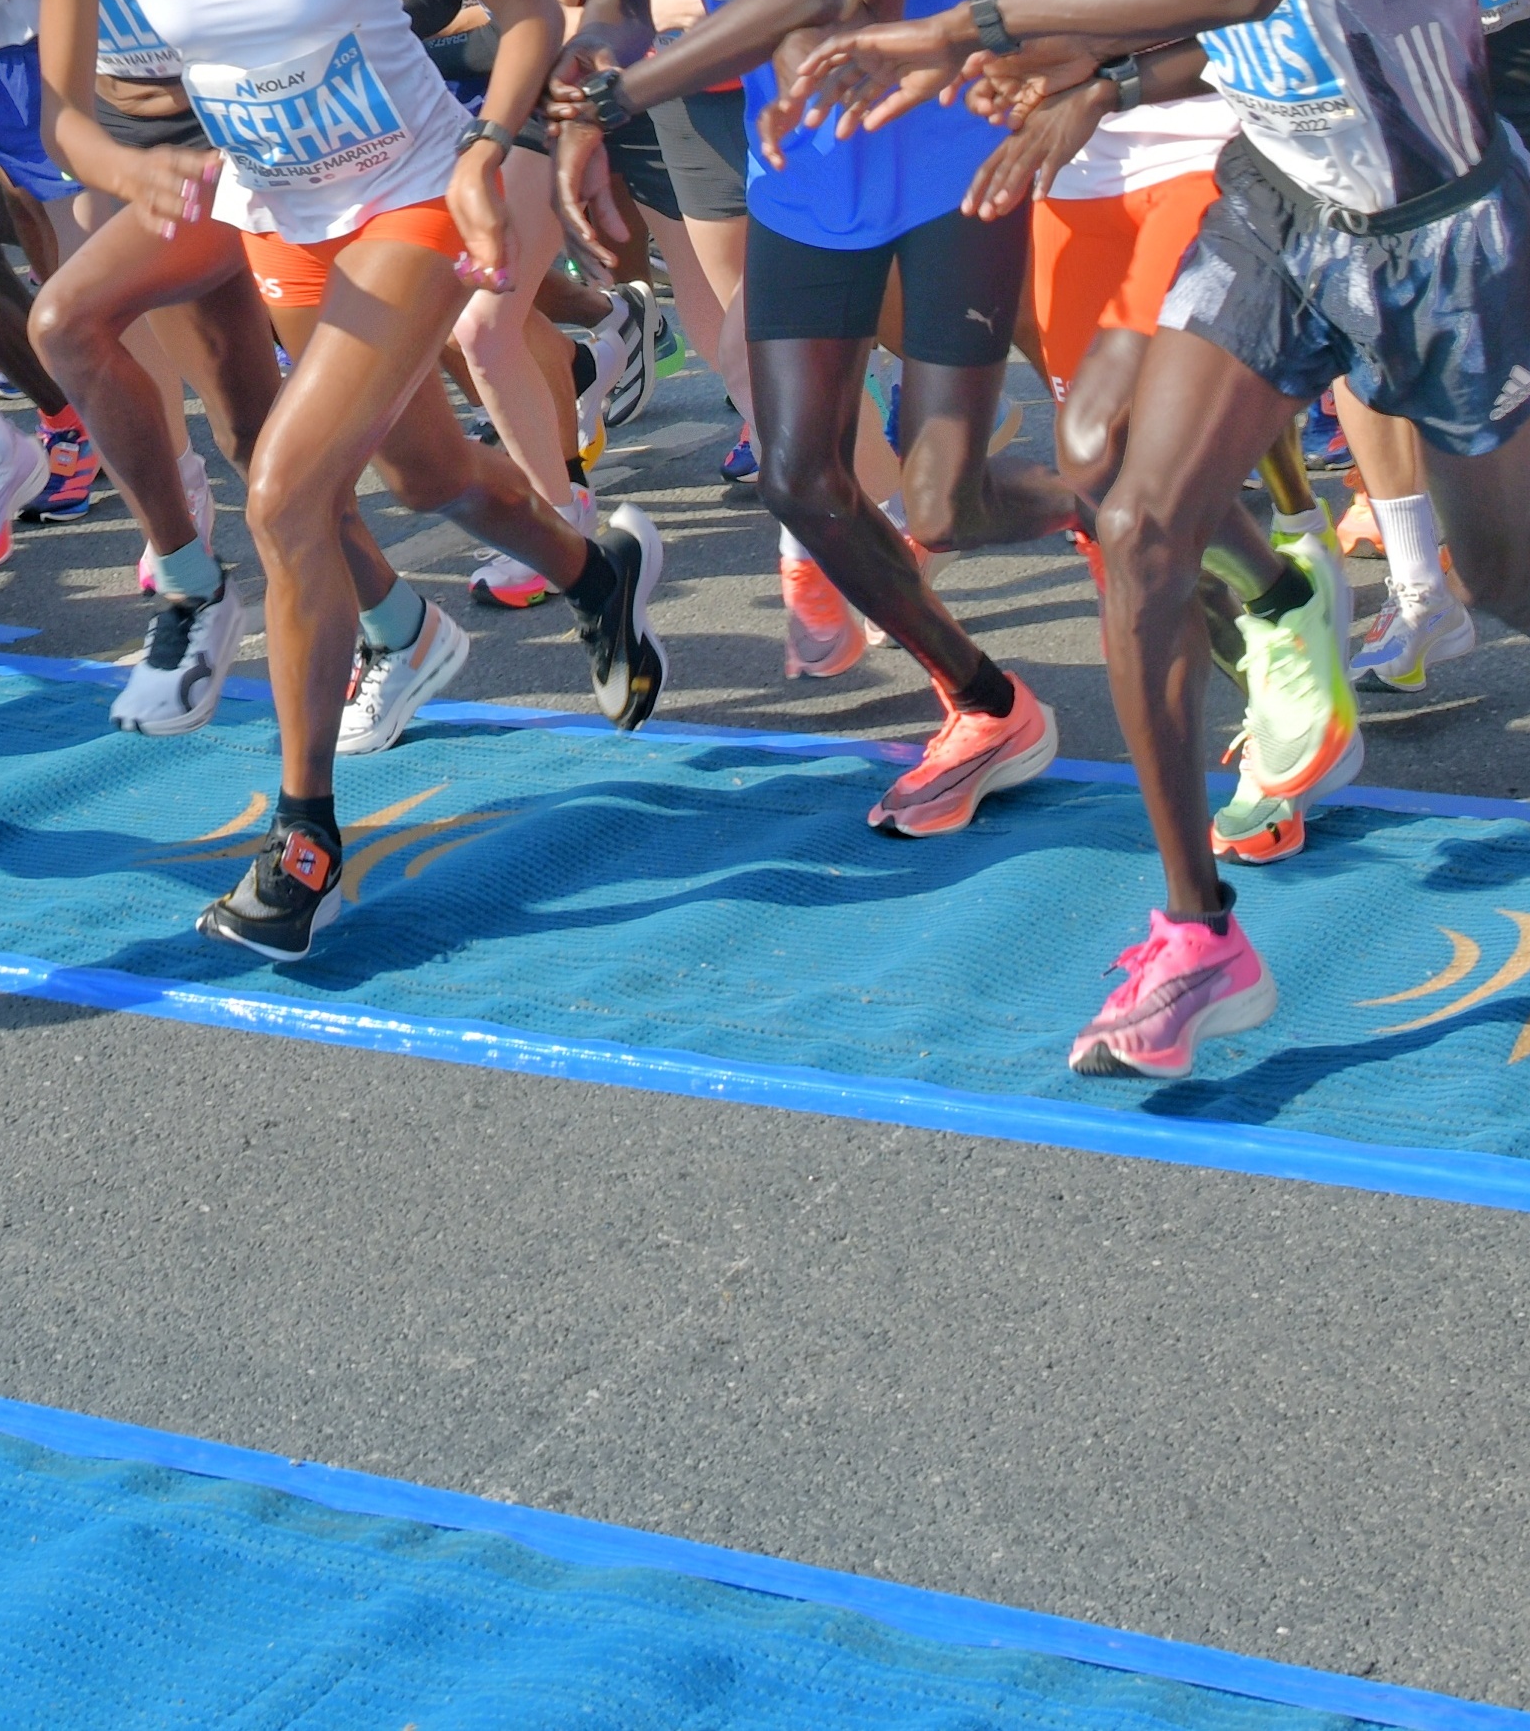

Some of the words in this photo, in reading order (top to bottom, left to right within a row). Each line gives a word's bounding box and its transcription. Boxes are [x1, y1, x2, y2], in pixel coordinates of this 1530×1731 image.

[333, 46, 359, 70] 103
[255, 70, 306, 95] KOLAY
[199, 62, 384, 165] TSEHAY
[1289, 119, 1332, 133] 2022
[321, 130, 407, 172] MARATHON
[355, 151, 391, 174] 2022
